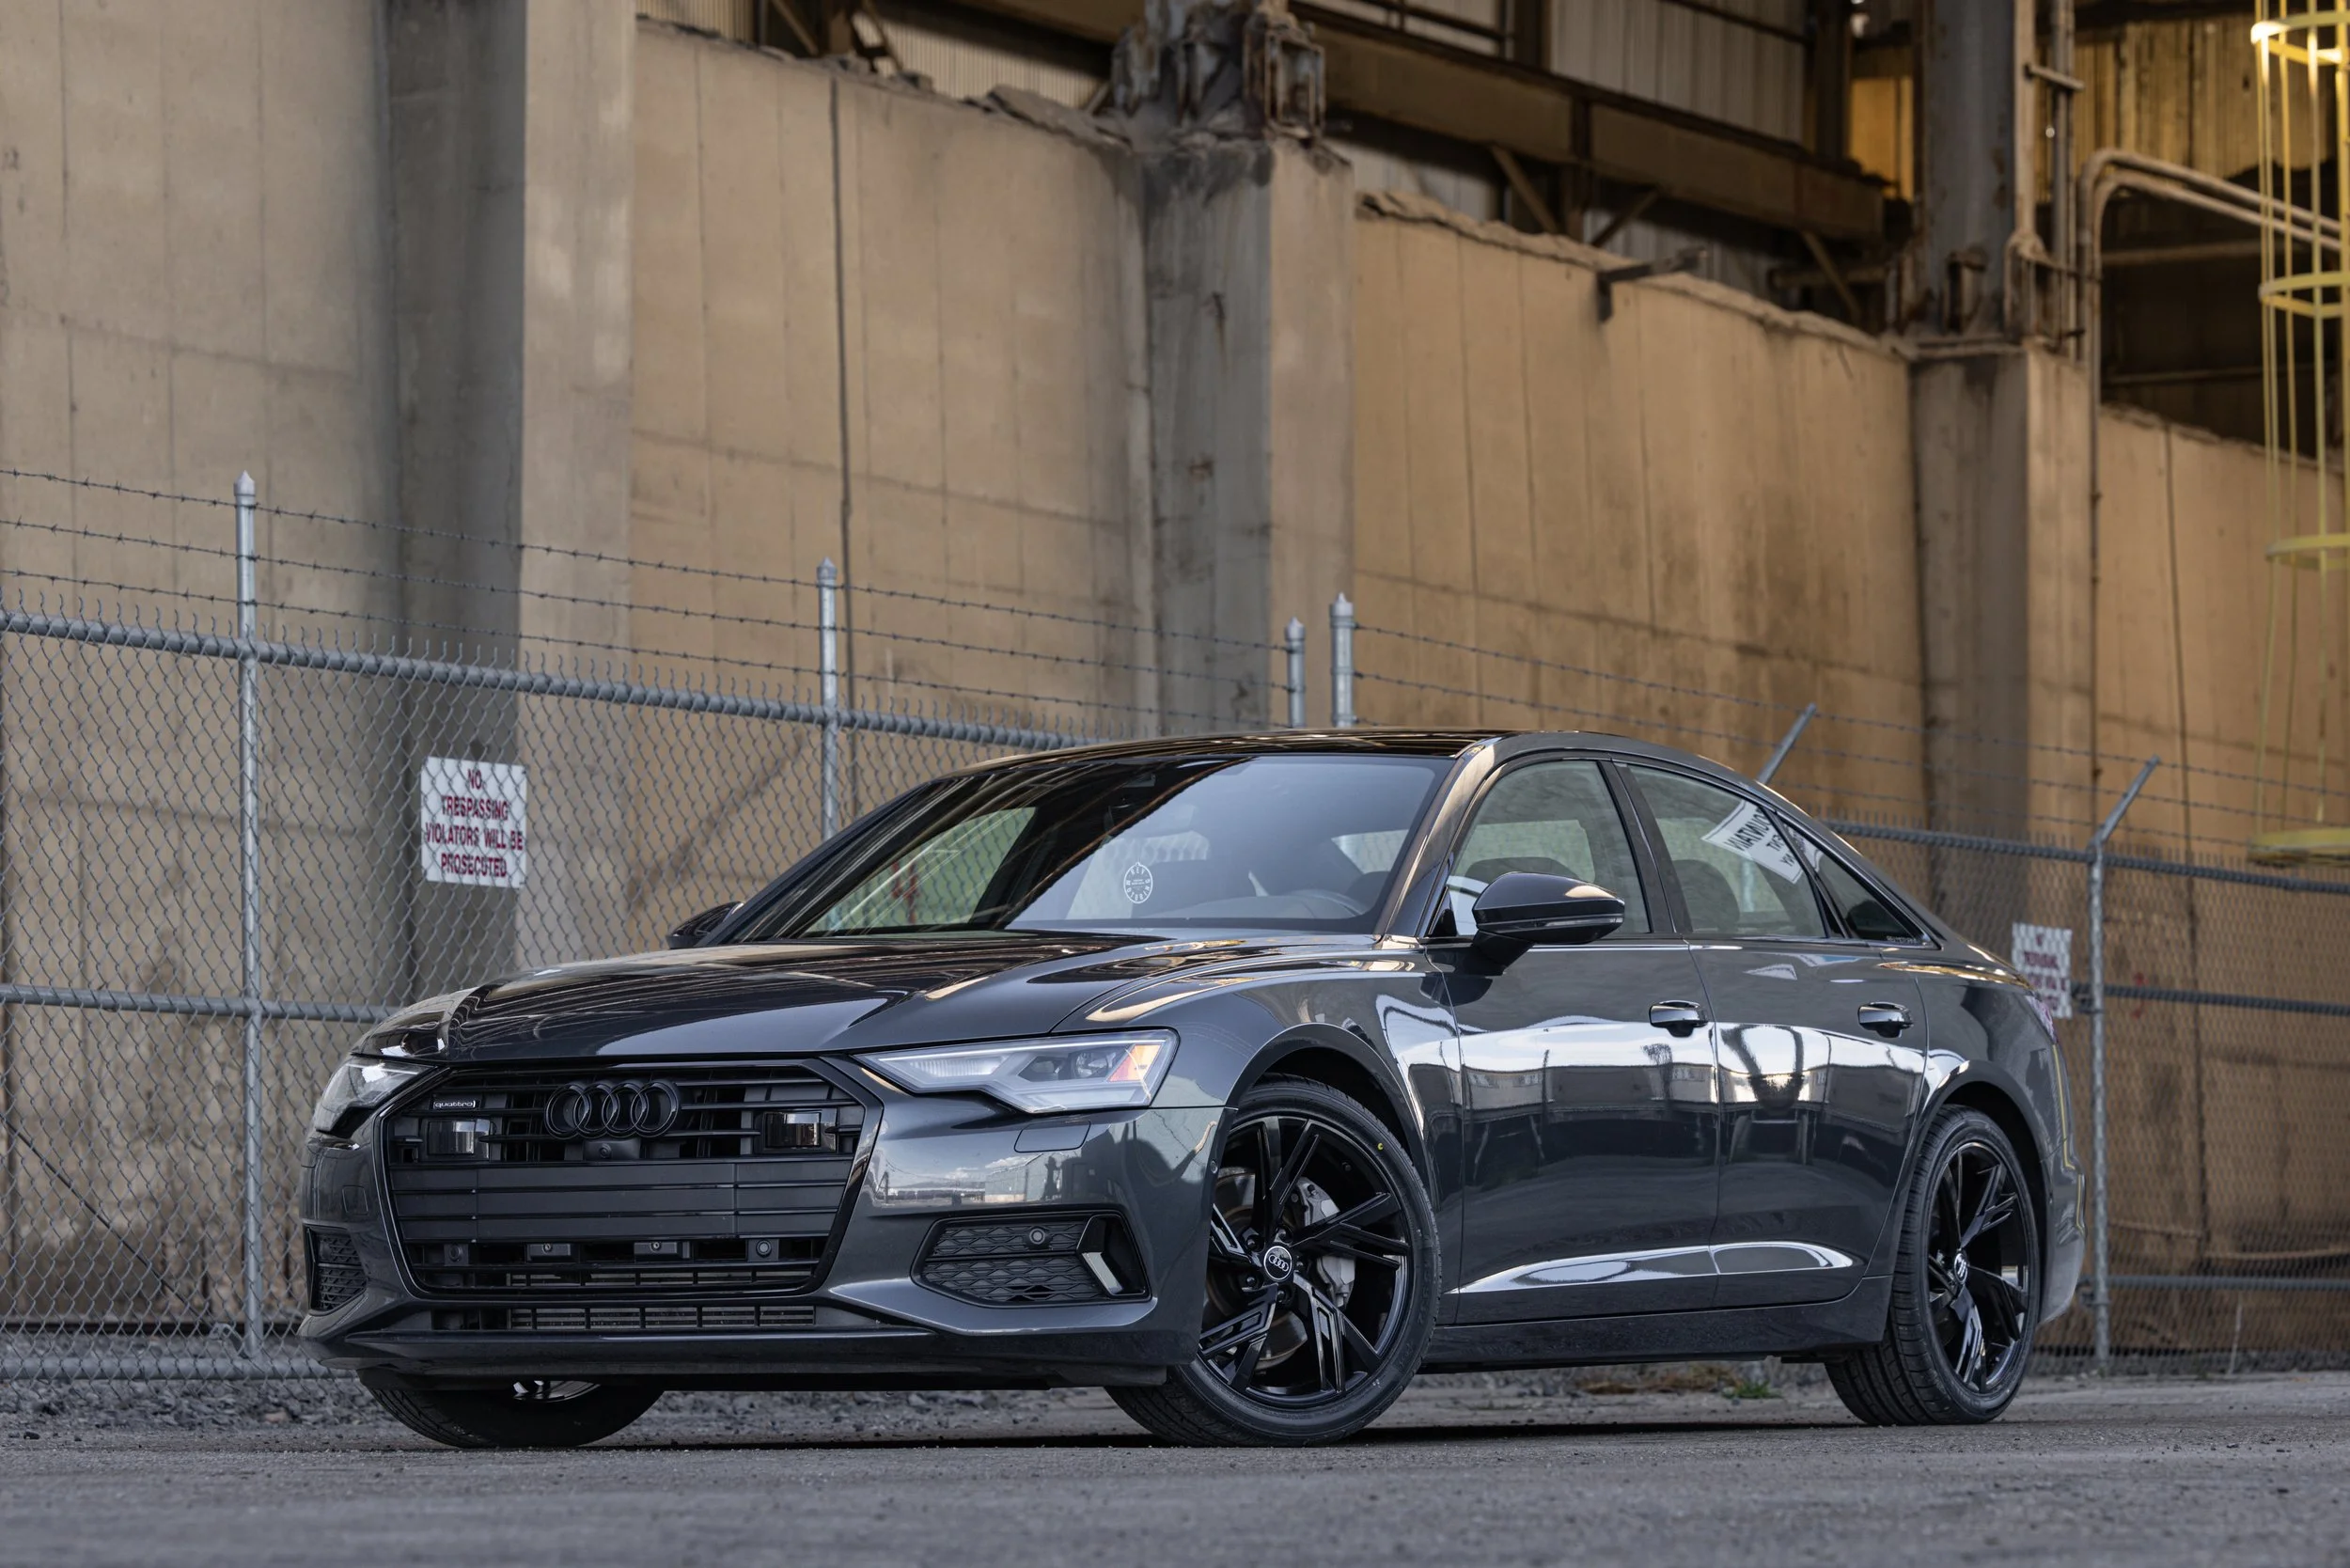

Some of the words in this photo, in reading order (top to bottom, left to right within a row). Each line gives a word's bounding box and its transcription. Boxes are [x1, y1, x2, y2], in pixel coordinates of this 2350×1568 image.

[468, 769, 482, 790] NO
[441, 796, 509, 821] TRESPASSING
[426, 823, 479, 845] VIOLATORS
[483, 828, 507, 849] WILL
[510, 831, 524, 851] BE
[441, 853, 508, 877] PROSECUTED
